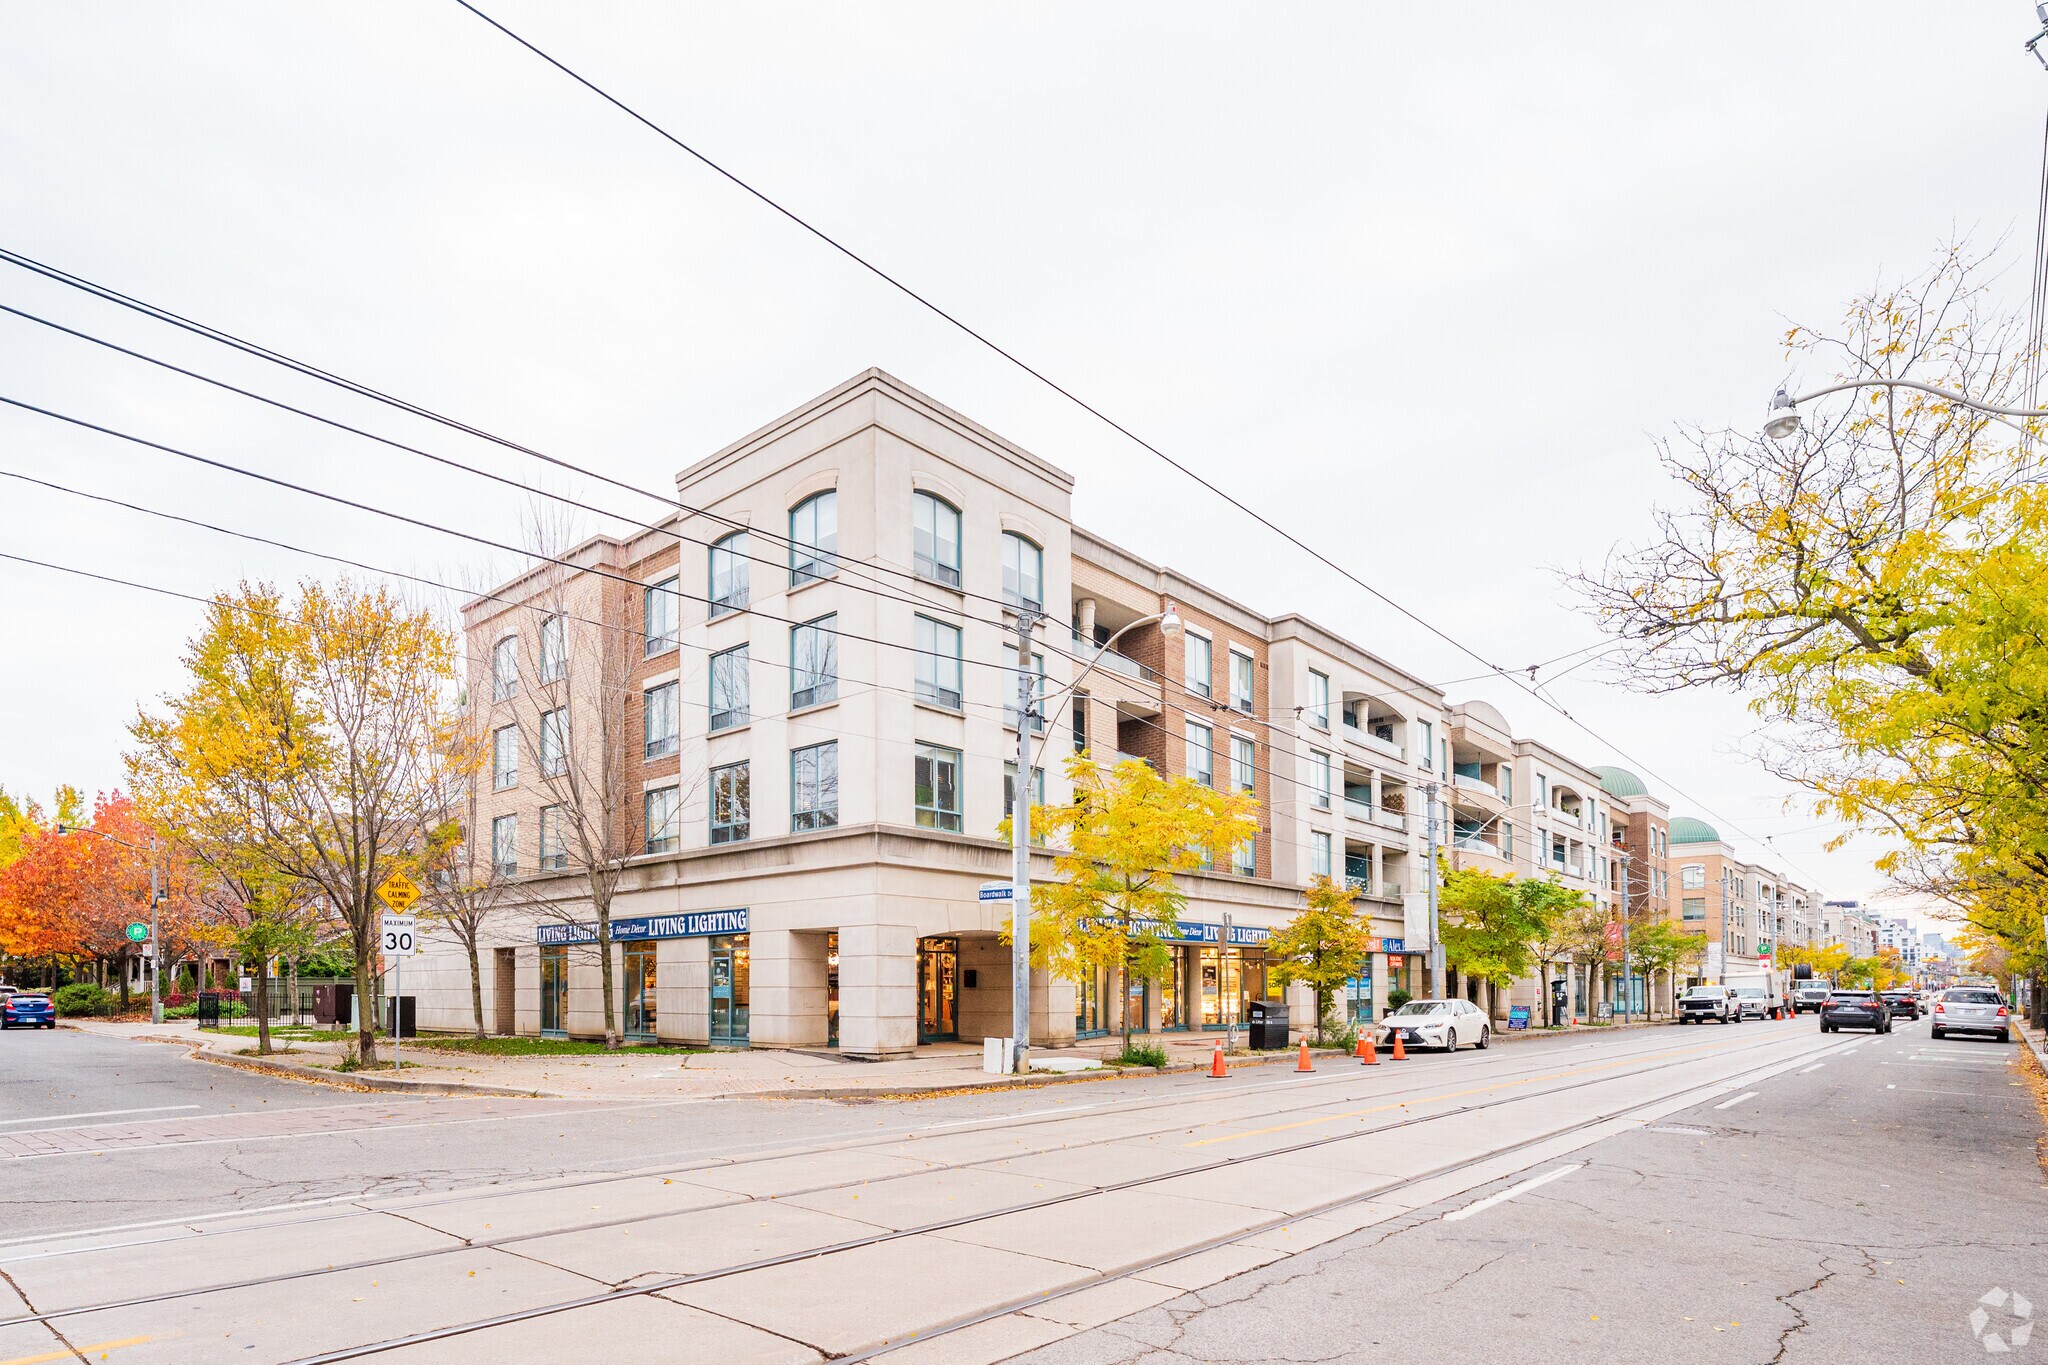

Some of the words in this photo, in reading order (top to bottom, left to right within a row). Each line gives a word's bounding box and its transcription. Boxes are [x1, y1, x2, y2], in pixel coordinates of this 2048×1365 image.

[388, 881, 410, 889] TRAFFIC
[387, 891, 411, 899] CALMING
[392, 900, 406, 908] ZONE
[538, 926, 567, 942] LIVING
[568, 923, 614, 941] LIGHTIG
[615, 926, 630, 934] Home
[648, 916, 686, 936] LIVING
[688, 911, 747, 933] LIGHTING
[385, 932, 412, 950] 30
[1204, 925, 1236, 942] LIVG
[1237, 928, 1273, 943] LIGHTIN
